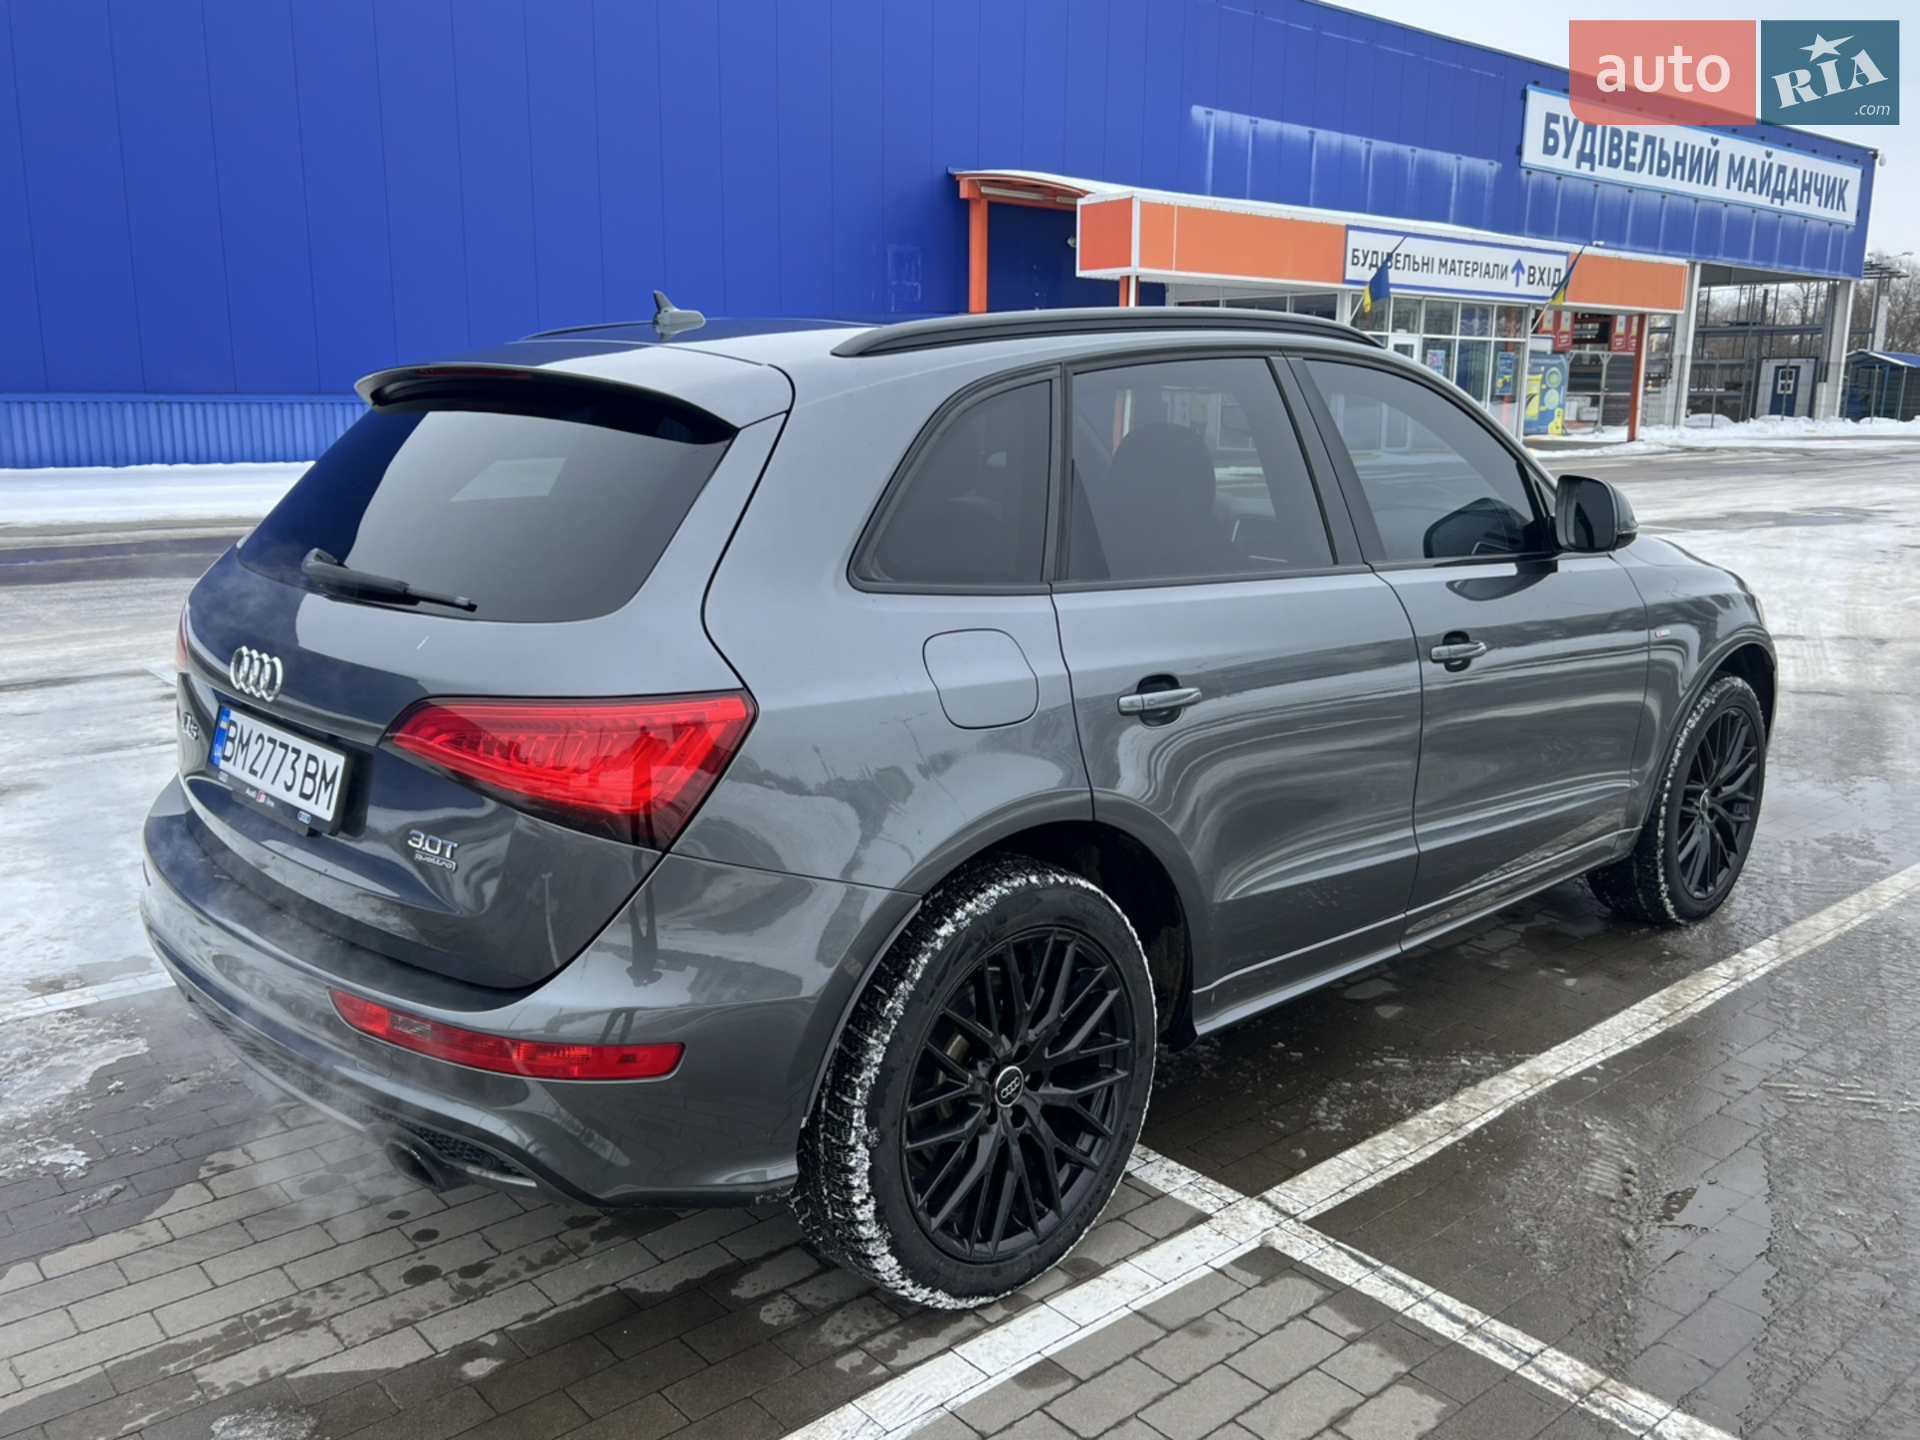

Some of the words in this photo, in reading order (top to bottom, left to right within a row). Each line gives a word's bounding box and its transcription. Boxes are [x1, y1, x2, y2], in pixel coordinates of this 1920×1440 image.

[1542, 111, 1720, 188] БУДІВЕЛЬНИЙ
[1725, 149, 1850, 213] МАЙДАНЧИК
[1438, 257, 1509, 281] МАТЕРІАЛИ
[1527, 264, 1562, 291] ВХІД
[407, 828, 459, 859] 3.0T
